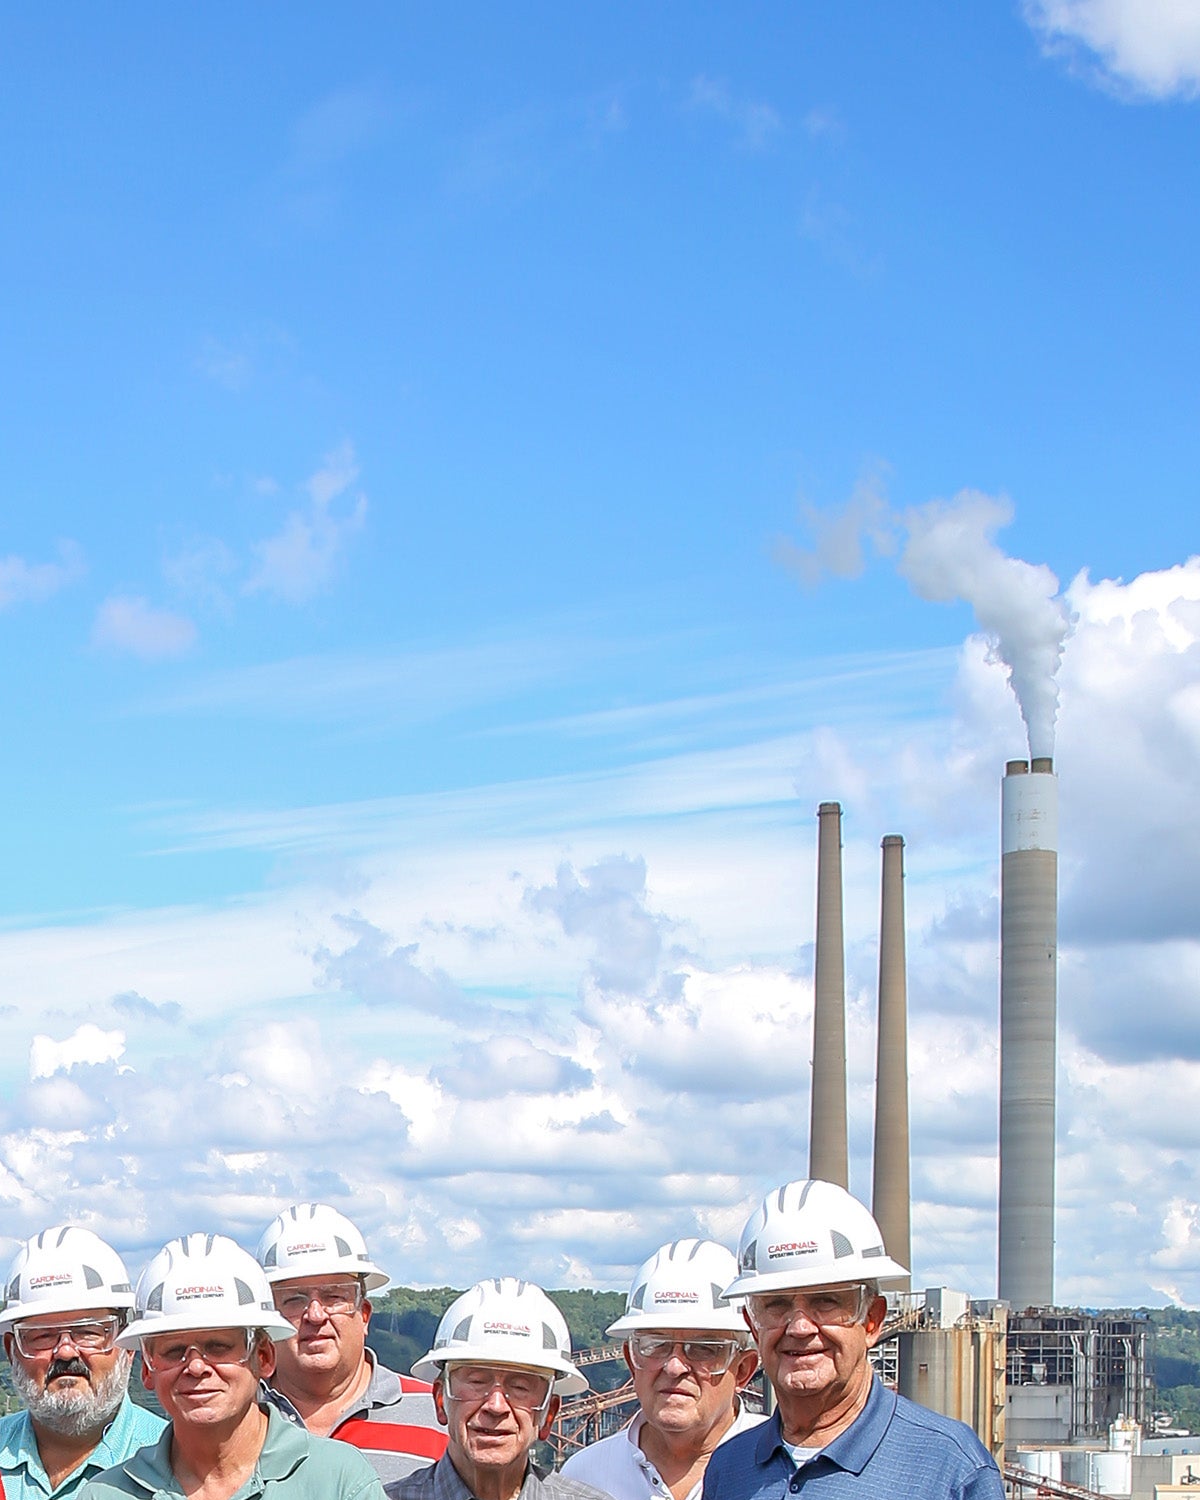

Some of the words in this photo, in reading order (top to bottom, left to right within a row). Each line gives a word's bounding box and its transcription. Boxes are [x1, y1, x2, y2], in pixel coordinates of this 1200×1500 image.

[768, 1241, 818, 1253] CARDINAL
[30, 1273, 72, 1285] CARDINAL
[176, 1286, 224, 1295] CARDINAL
[655, 1291, 699, 1299] CARDINAL
[484, 1322, 531, 1332] CARDINAL
